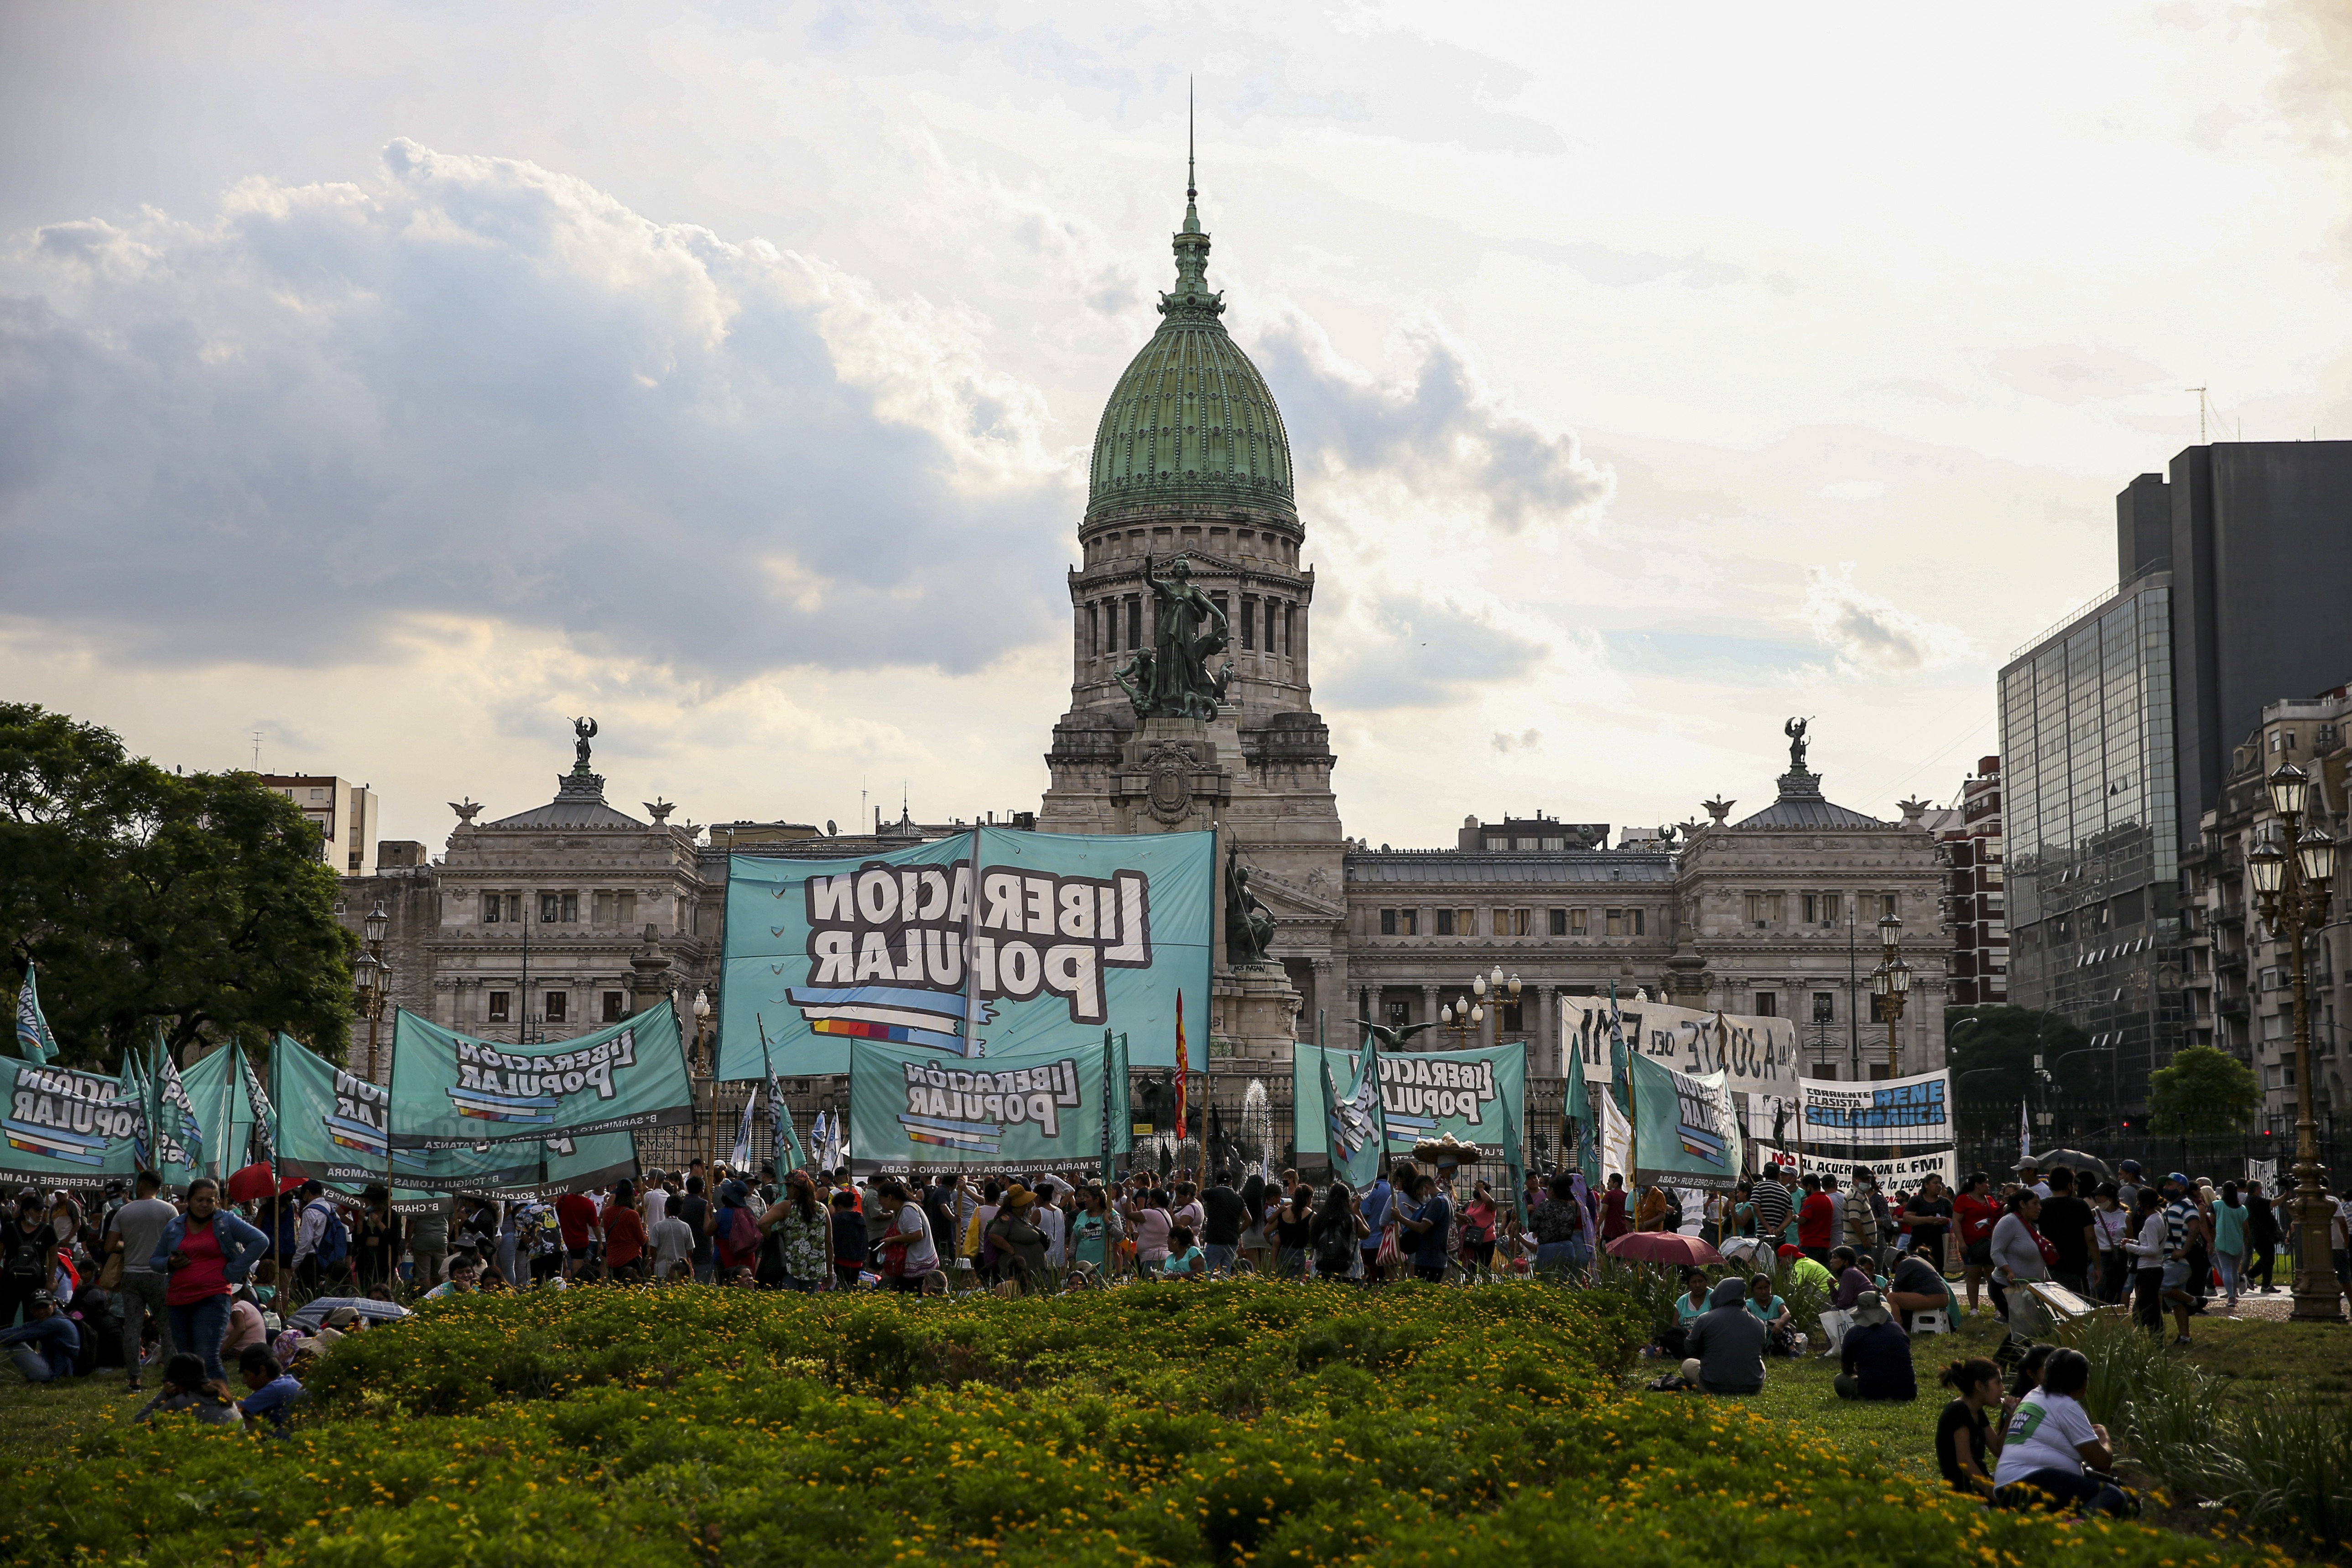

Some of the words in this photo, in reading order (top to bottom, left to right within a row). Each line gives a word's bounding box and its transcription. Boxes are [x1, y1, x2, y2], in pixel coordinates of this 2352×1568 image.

[1806, 1088, 1871, 1099] CORRIENTE
[1873, 1079, 1945, 1107] RENE
[1807, 1096, 1861, 1107] CLASISTA
[1806, 1104, 1946, 1127] SALAMANCA
[1871, 1164, 1893, 1175] CON
[1897, 1162, 1907, 1173] EL
[1911, 1157, 1943, 1173] FMI
[1888, 1177, 1898, 1189] la
